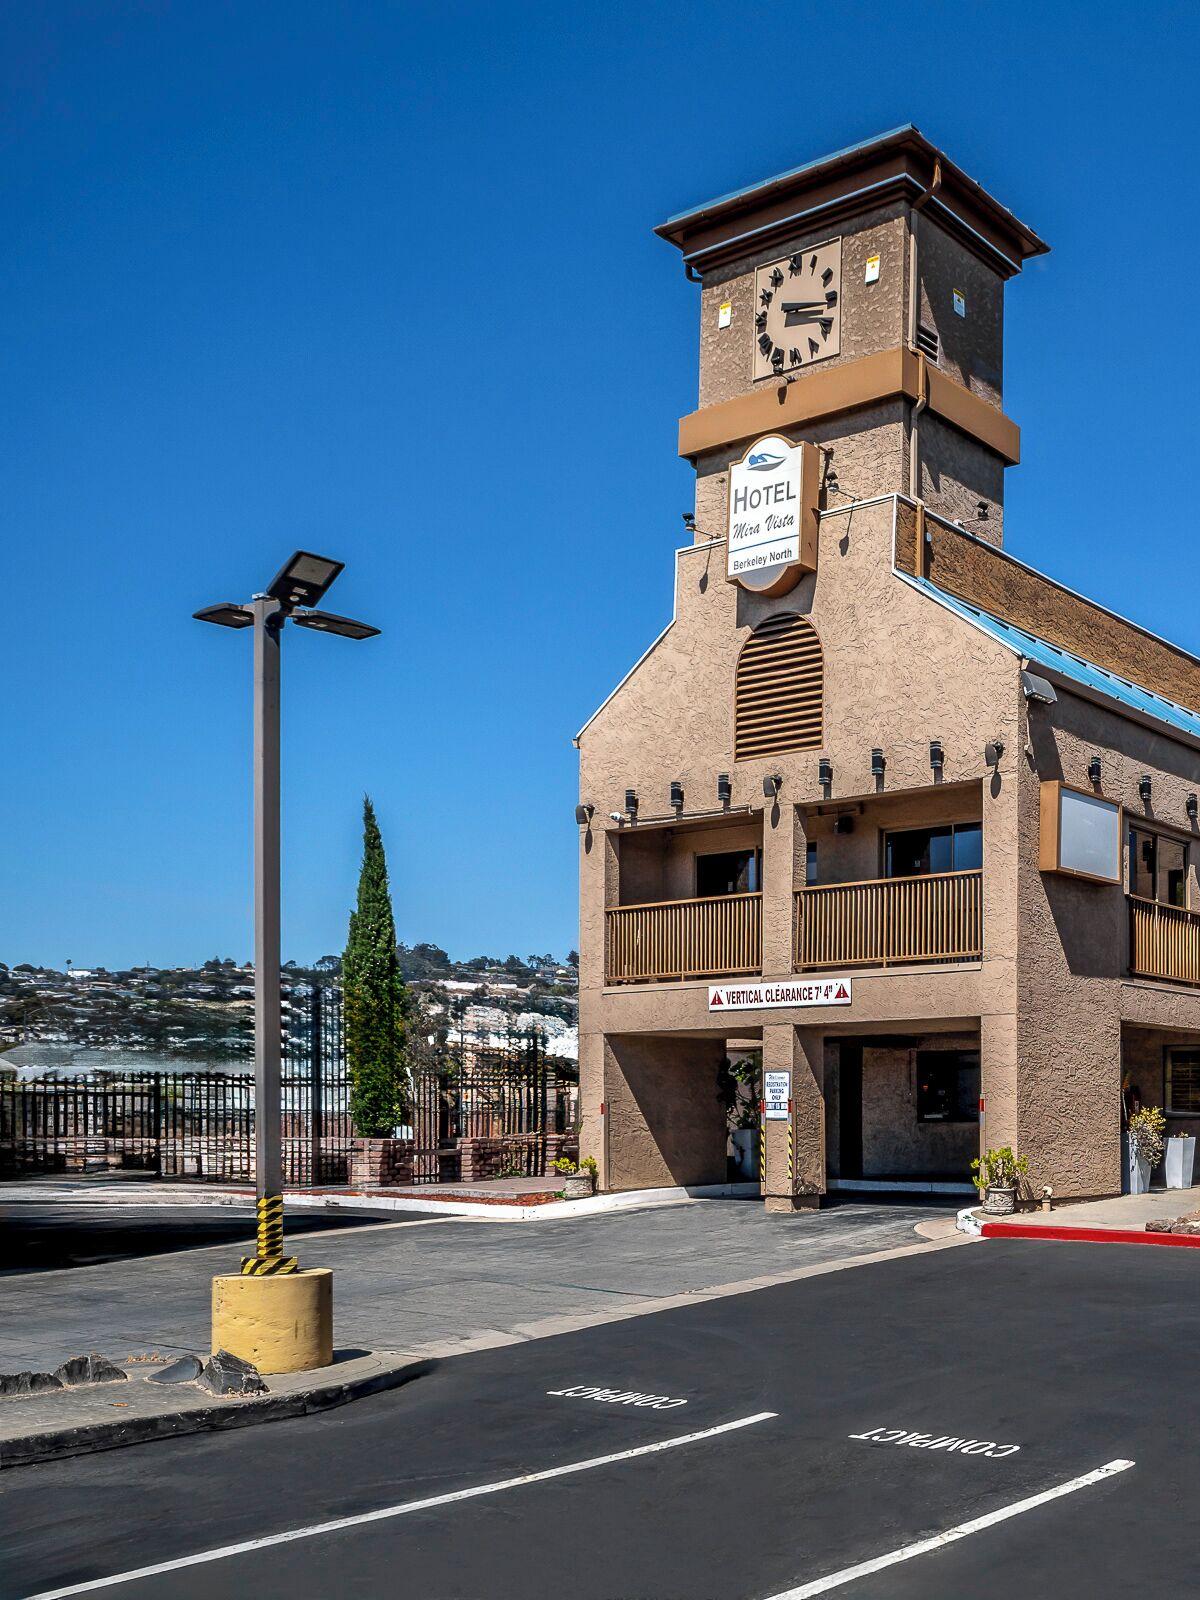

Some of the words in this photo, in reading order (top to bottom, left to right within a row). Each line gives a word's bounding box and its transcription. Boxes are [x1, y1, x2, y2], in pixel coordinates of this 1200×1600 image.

[733, 522, 760, 540] Mira
[765, 513, 795, 532] Vista
[733, 554, 768, 571] Berkeley
[769, 548, 793, 562] North
[726, 989, 764, 1005] VERTICAL
[765, 986, 813, 1003] CLEARANCE
[547, 1386, 688, 1409] COMPACT
[848, 1427, 1021, 1458] COMPACT
